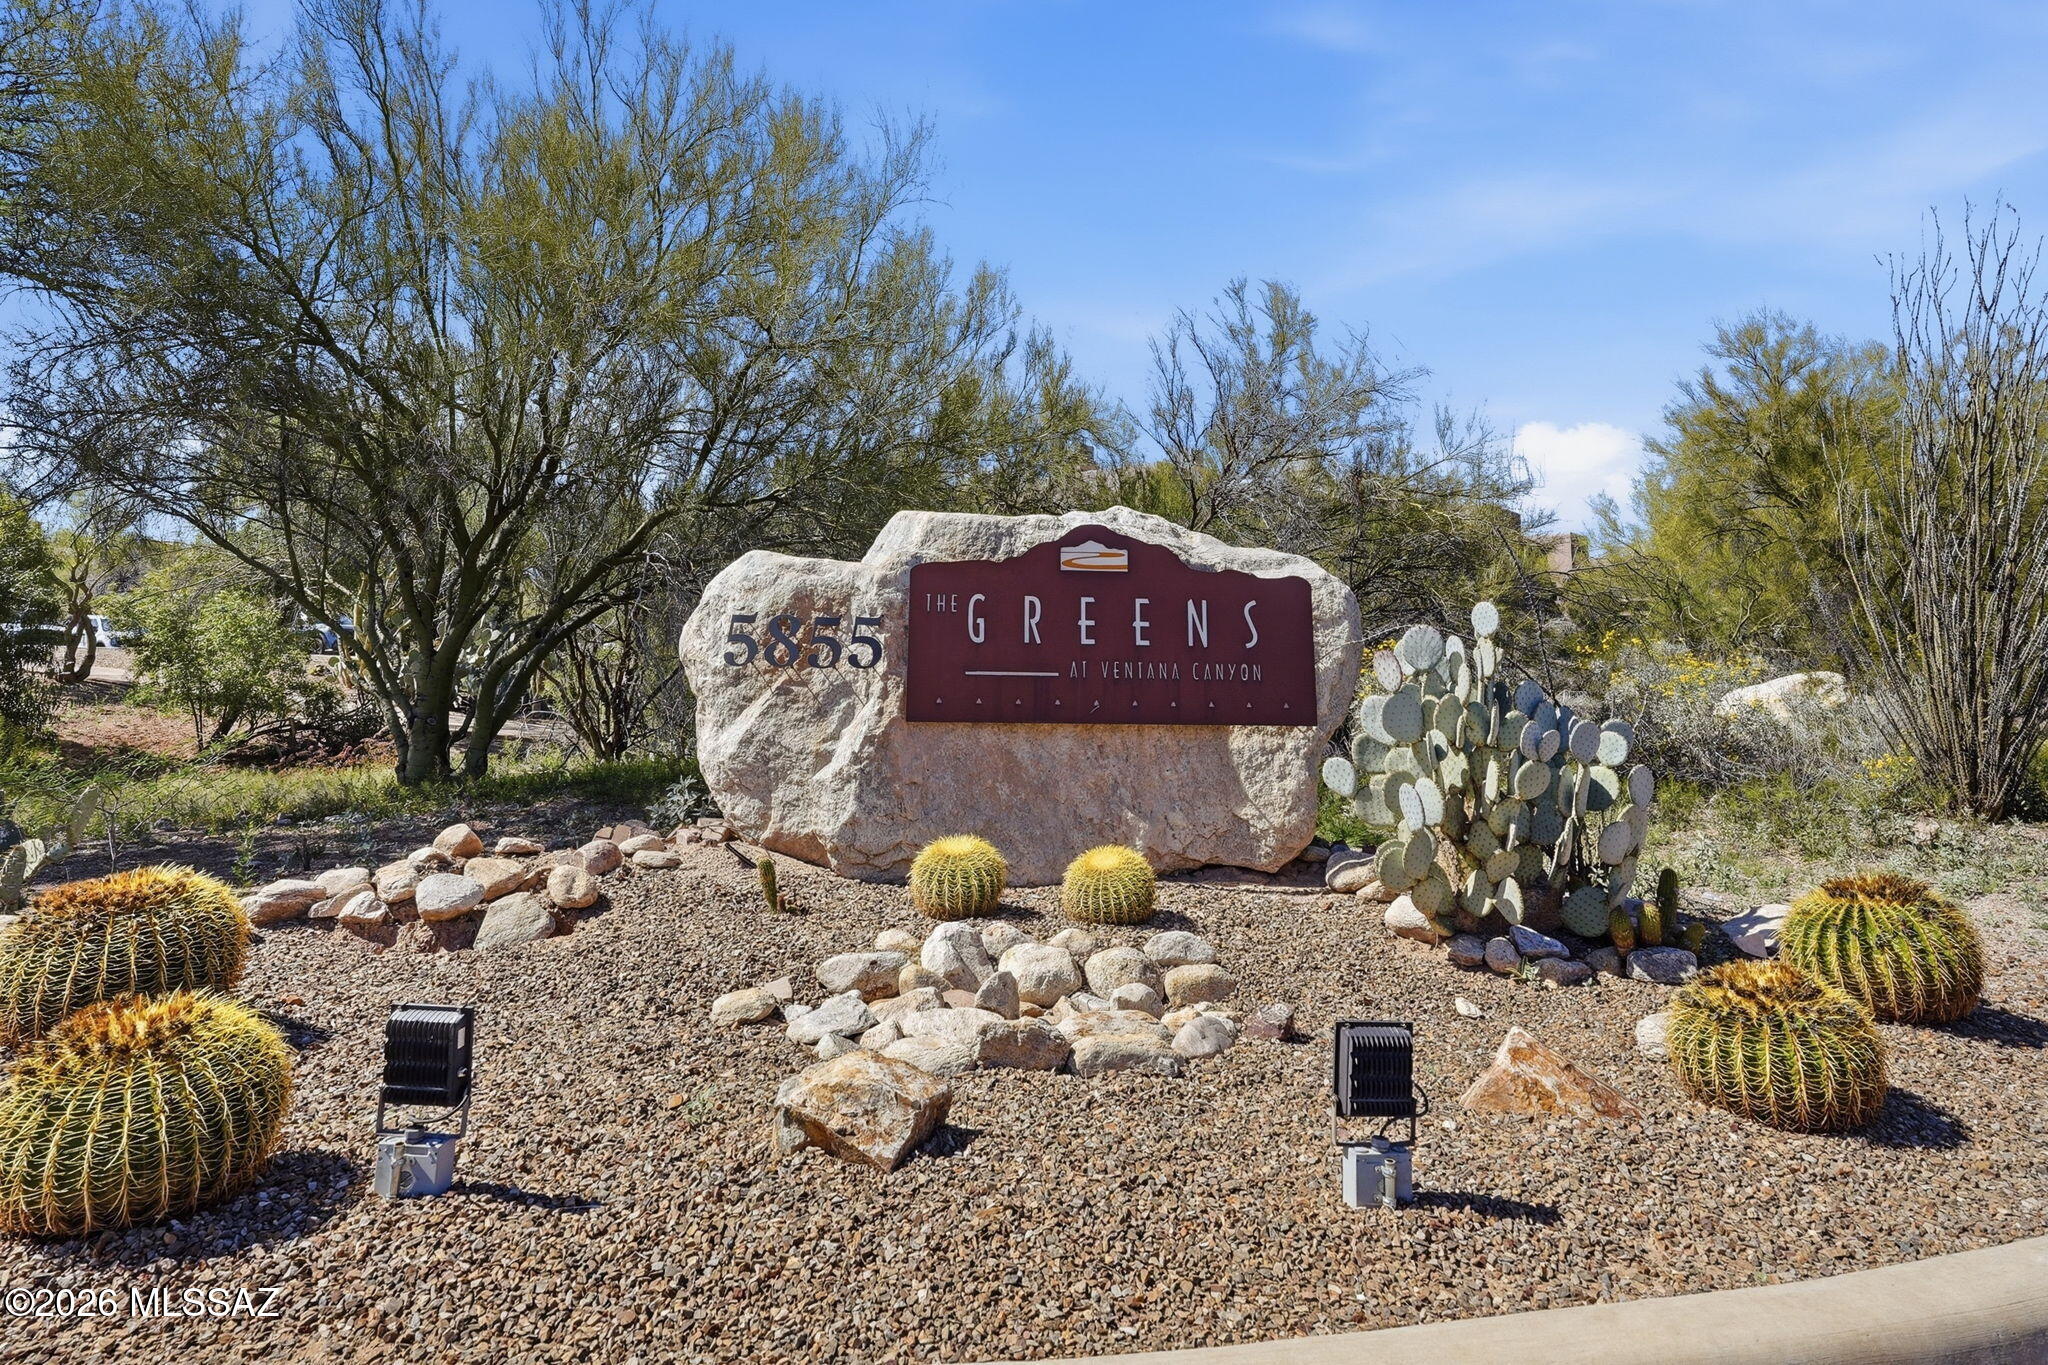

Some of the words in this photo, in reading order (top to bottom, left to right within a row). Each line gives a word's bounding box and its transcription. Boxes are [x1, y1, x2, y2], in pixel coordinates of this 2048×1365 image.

[723, 611, 884, 669] 5855
[926, 593, 958, 613] THE
[966, 593, 1259, 649] GREENS
[1069, 660, 1088, 679] AT
[1100, 661, 1181, 681] VENTANA
[1192, 662, 1263, 682] CANYON
